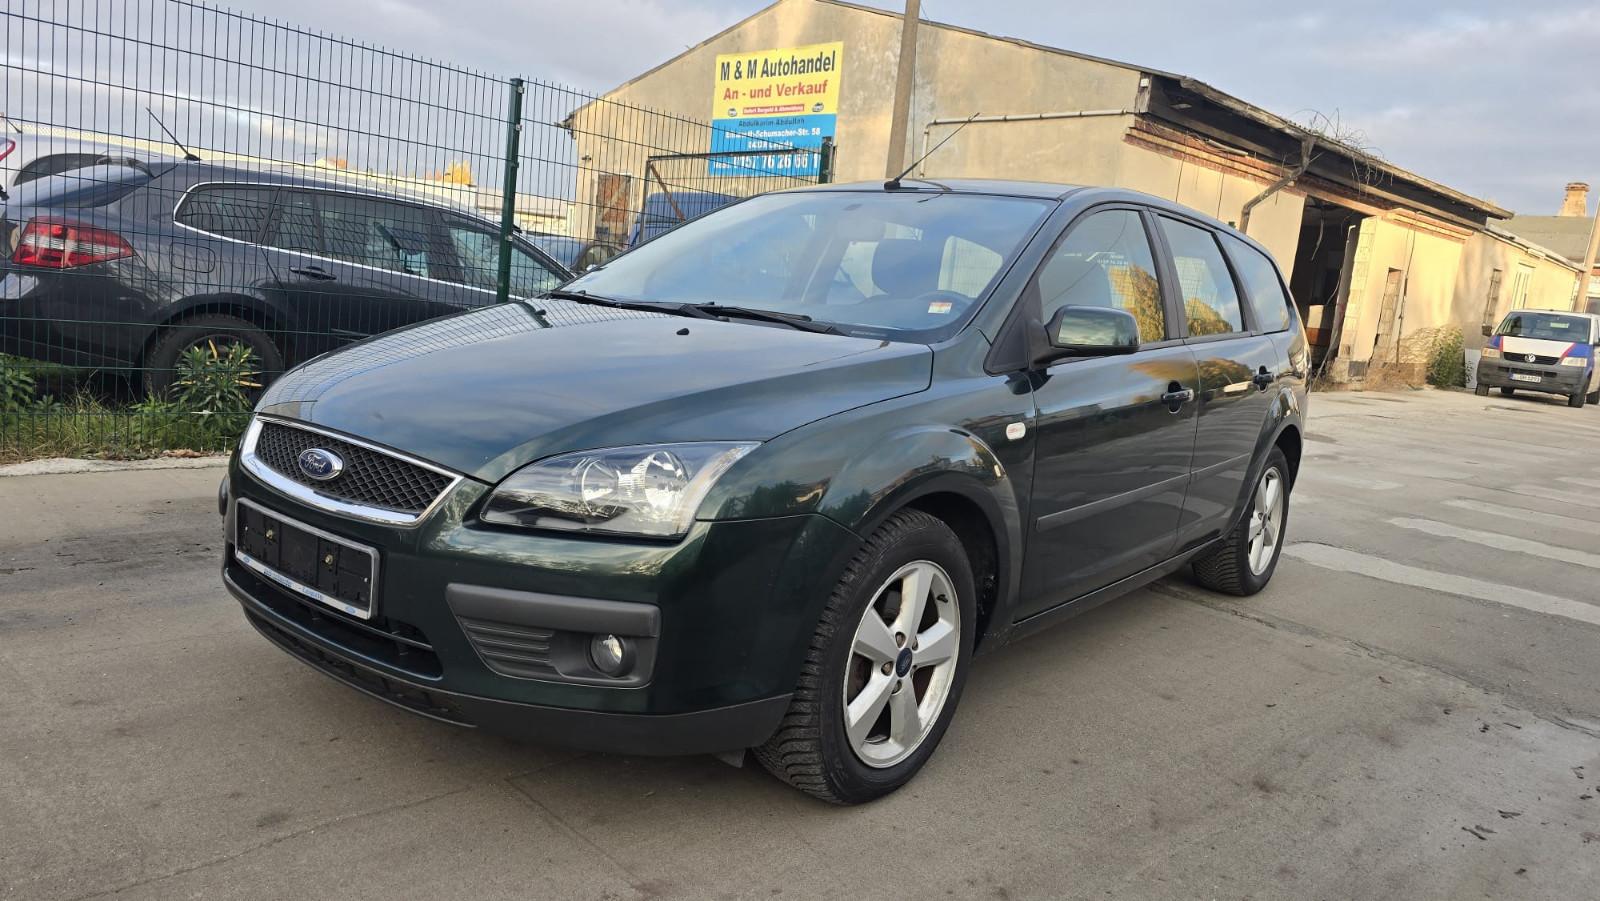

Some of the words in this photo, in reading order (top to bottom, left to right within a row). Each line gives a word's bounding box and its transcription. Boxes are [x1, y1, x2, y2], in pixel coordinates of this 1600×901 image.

[720, 61, 731, 81] M
[734, 60, 743, 80] &
[747, 58, 758, 79] M
[761, 50, 836, 78] Autohandel
[723, 87, 739, 100] An
[750, 84, 773, 99] und
[776, 79, 829, 97] Verkauf
